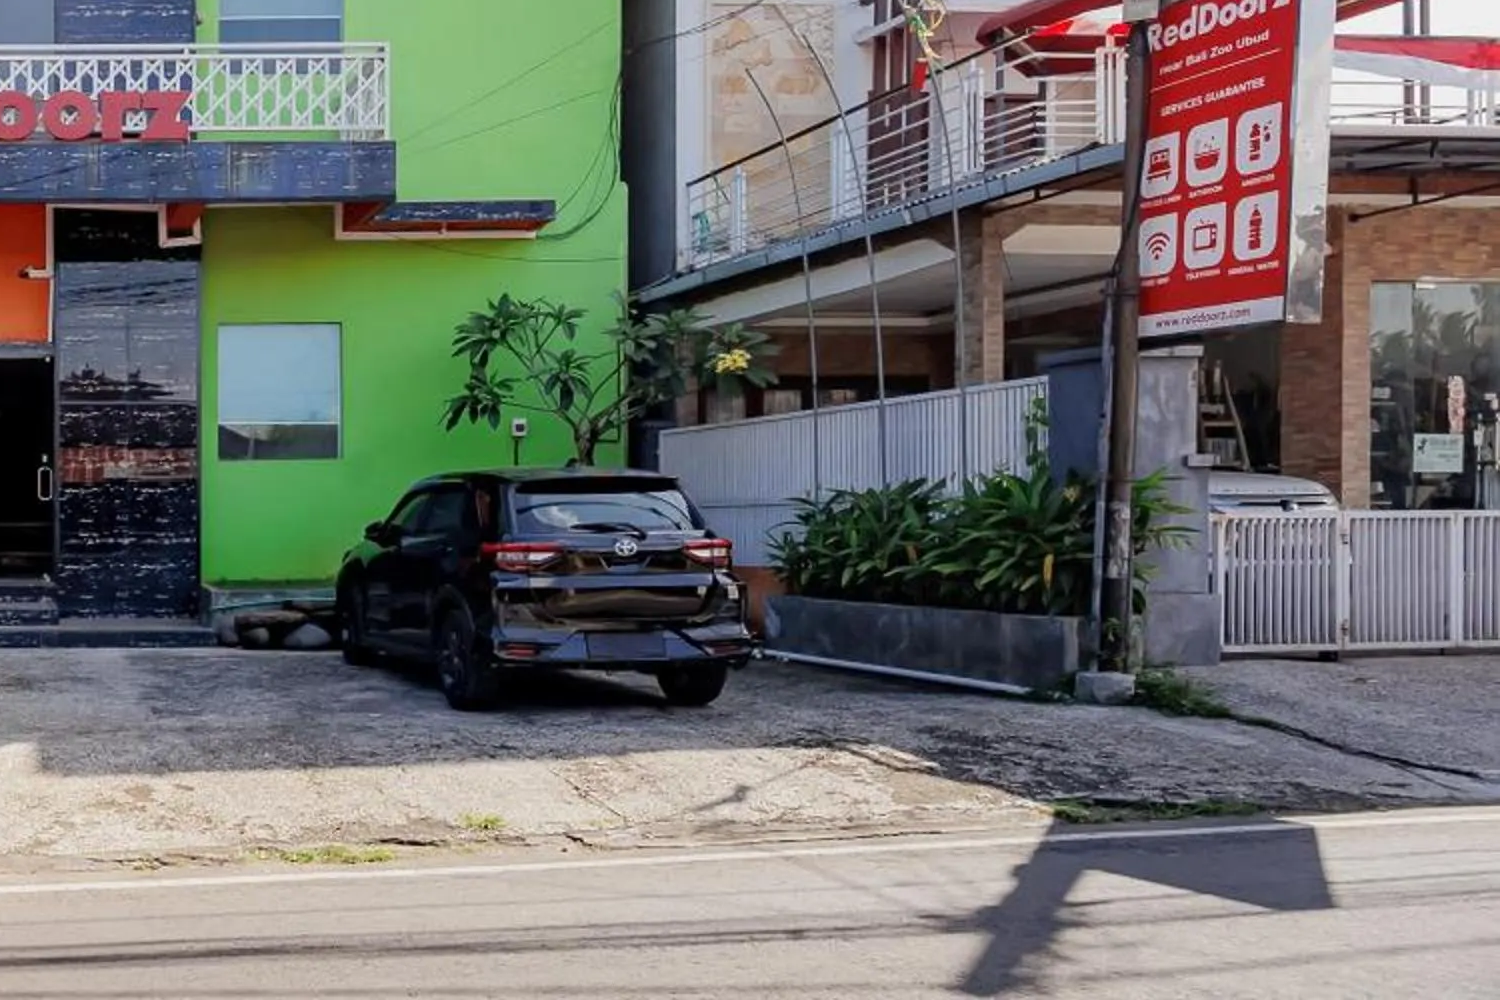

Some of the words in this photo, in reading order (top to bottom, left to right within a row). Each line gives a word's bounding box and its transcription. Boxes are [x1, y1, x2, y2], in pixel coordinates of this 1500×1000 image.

[1209, 43, 1234, 59] Zoo
[1235, 29, 1270, 49] Ubud
[1160, 95, 1203, 117] SERVICES
[1203, 76, 1266, 103] GUARANTEE
[1156, 308, 1250, 327] www.reddoorz.com
